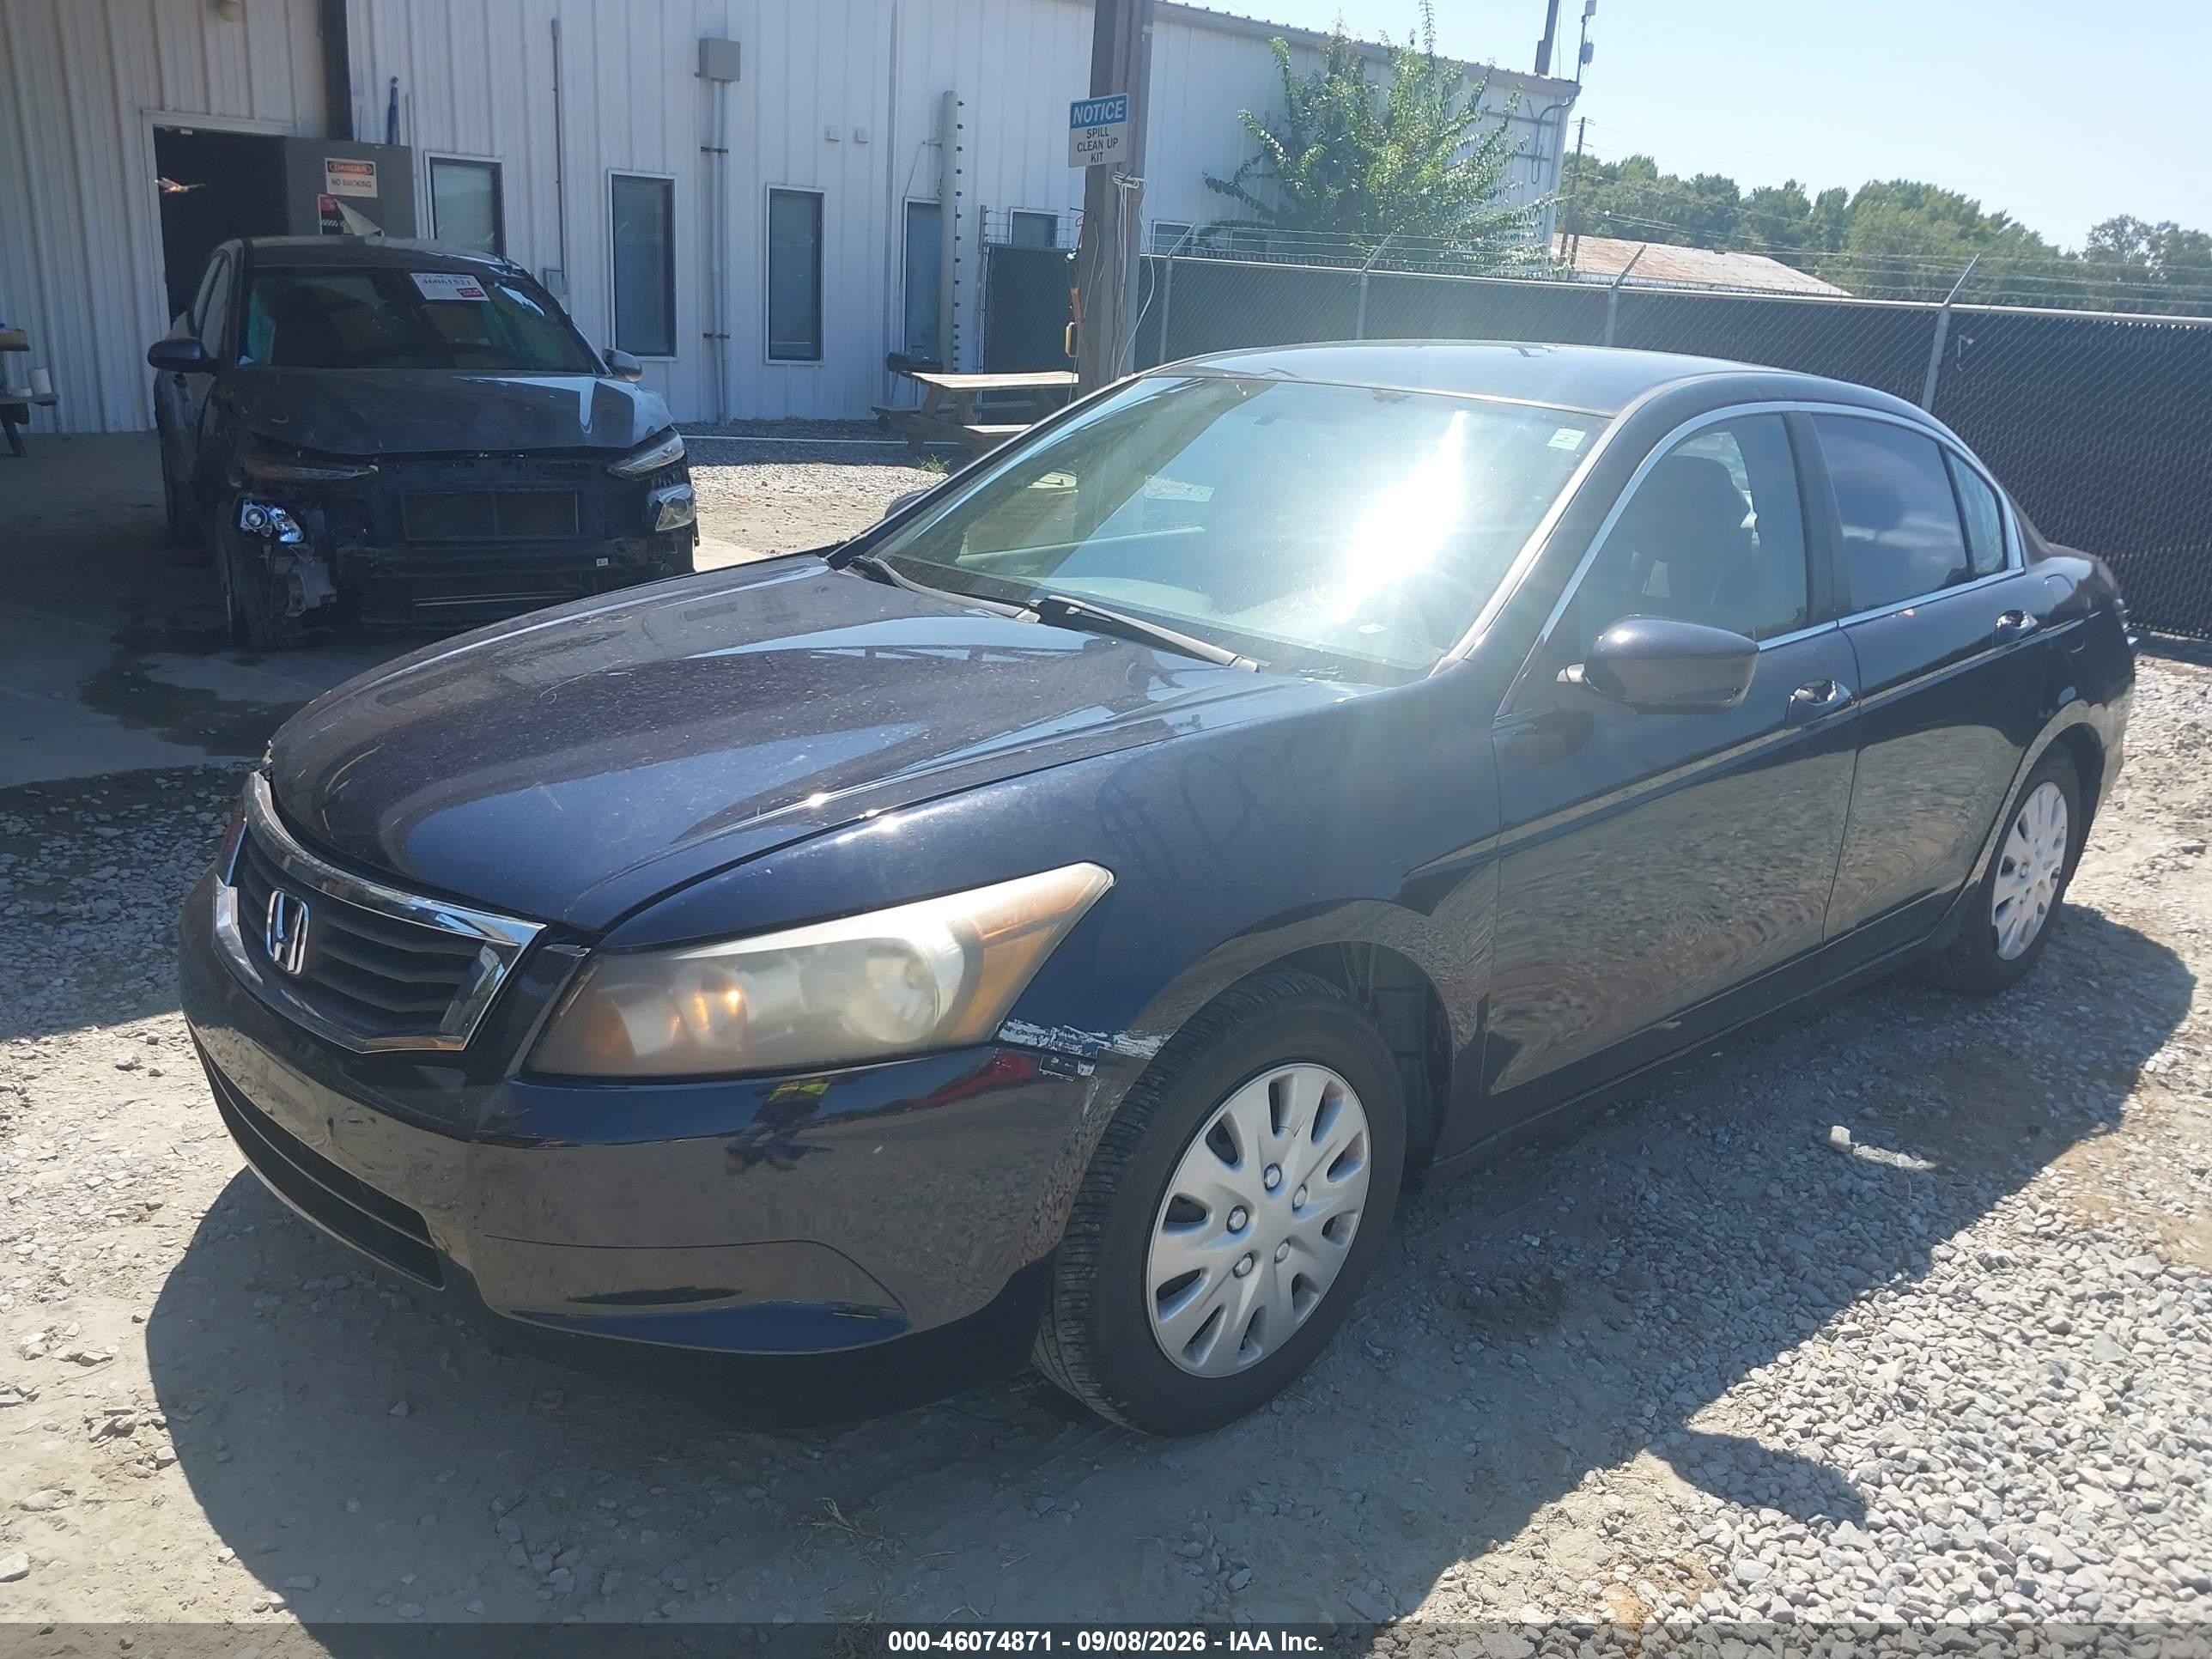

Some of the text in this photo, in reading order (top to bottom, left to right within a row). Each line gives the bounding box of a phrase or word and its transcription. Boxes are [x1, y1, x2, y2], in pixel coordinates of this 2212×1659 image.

[1073, 100, 1125, 125] NOTICE
[1086, 126, 1109, 139] SPILL
[1077, 137, 1119, 153] CLEAN UP
[1091, 151, 1104, 163] KIT
[334, 164, 369, 173] DANGER
[331, 178, 373, 188] NO SMOKING
